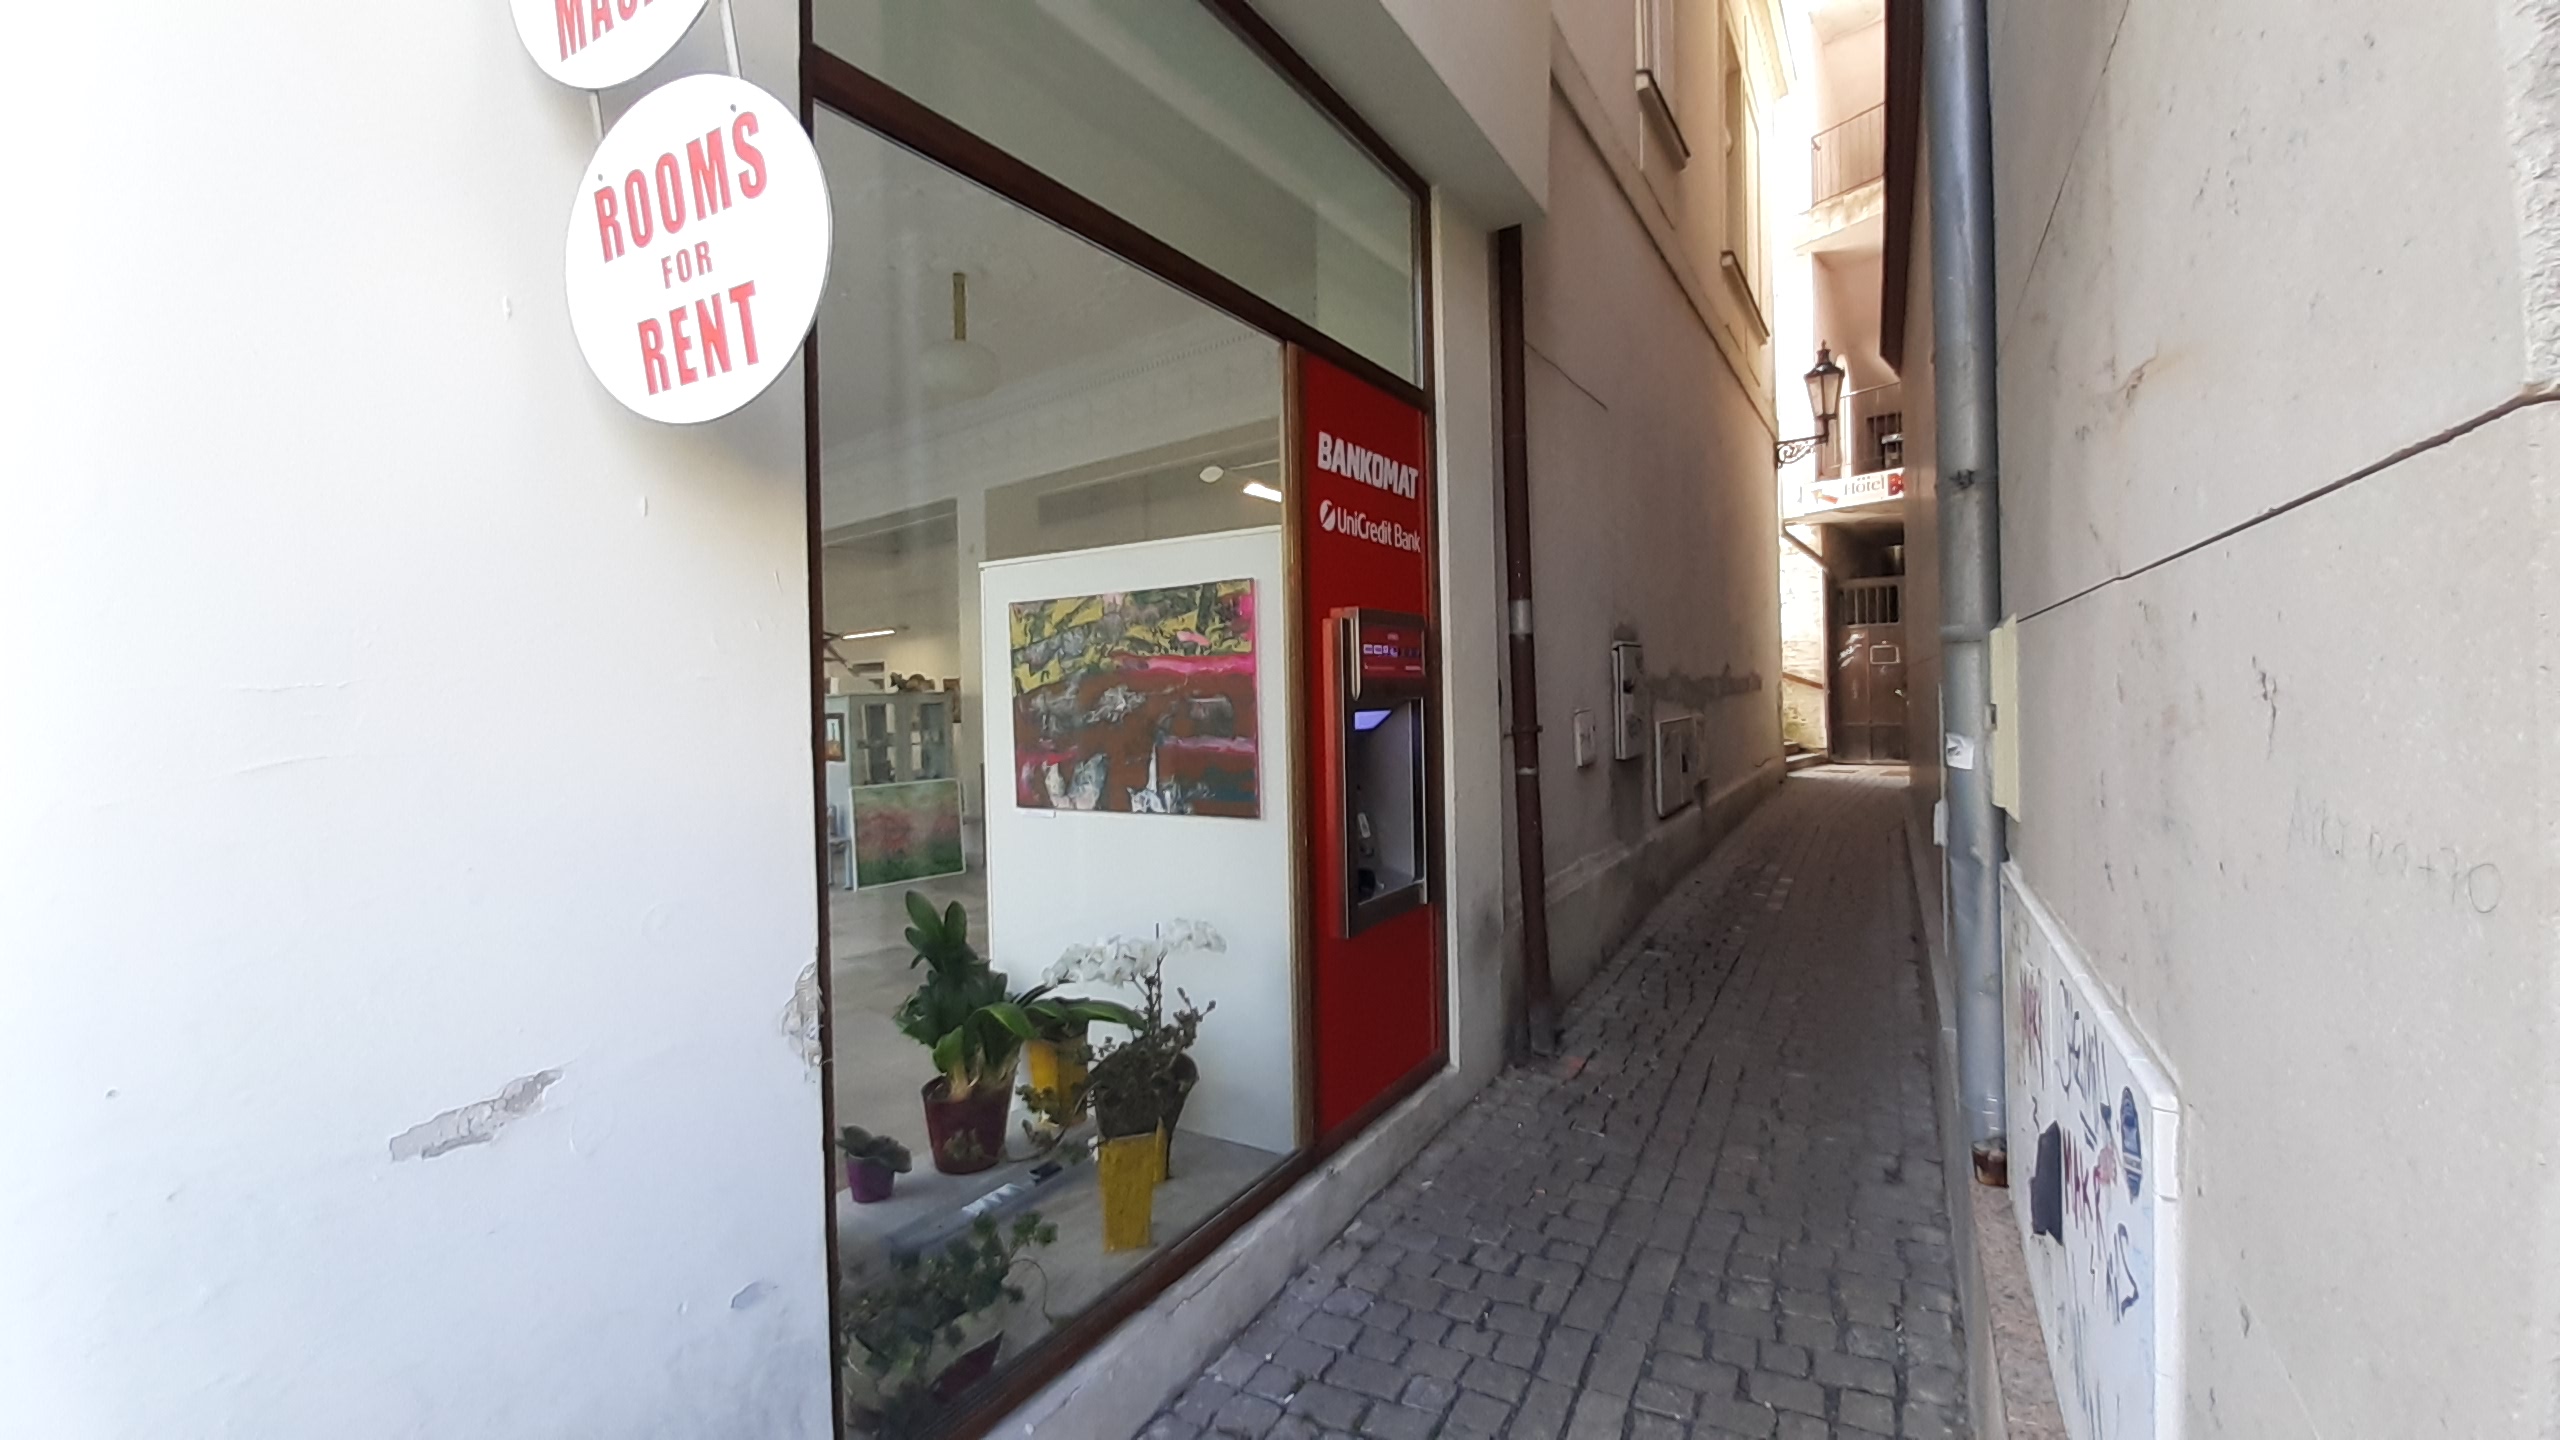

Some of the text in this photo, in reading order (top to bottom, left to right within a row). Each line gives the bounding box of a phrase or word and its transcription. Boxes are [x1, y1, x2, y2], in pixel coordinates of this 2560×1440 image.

[594, 111, 768, 263] ROOMS
[661, 240, 713, 289] FOR
[637, 280, 759, 396] RENT
[1317, 430, 1419, 499] BANKOMAT
[1844, 474, 1884, 495] Hotel
[1337, 506, 1420, 553] UniCredit Bank
